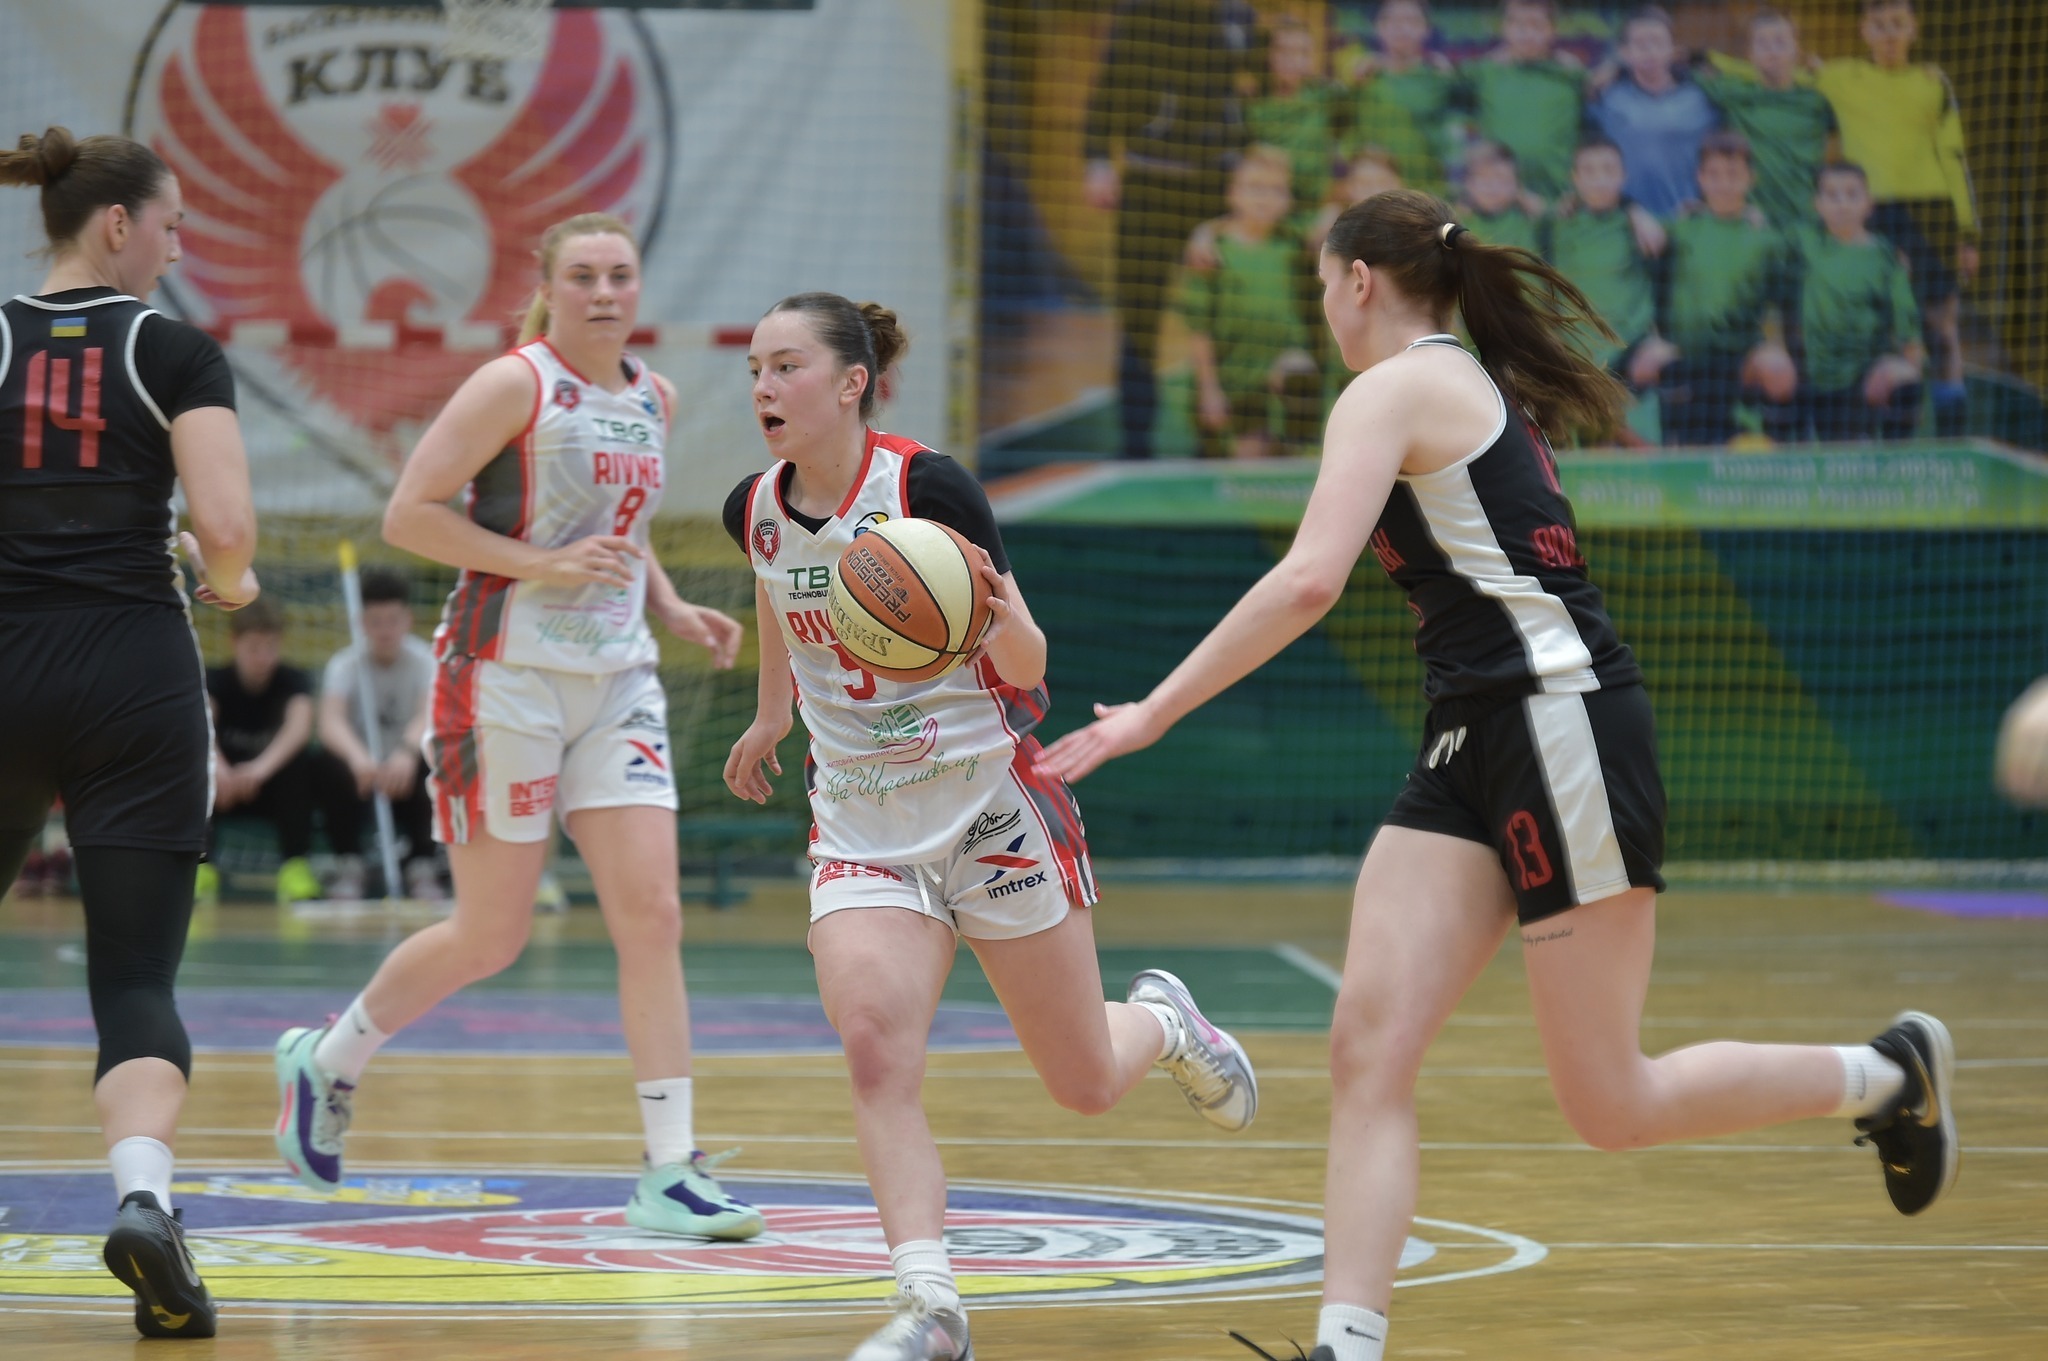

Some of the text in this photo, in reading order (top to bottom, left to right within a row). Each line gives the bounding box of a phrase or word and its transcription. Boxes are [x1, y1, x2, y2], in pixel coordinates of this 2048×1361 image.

[22, 346, 107, 469] 14
[592, 418, 649, 443] TBG
[593, 452, 661, 488] RIVNE
[787, 566, 830, 591] TB
[859, 547, 895, 586] 1000
[788, 590, 829, 601] TECHNOBU
[846, 551, 912, 623] PRECISION
[786, 609, 838, 644] RIV
[1506, 810, 1553, 890] 13
[987, 870, 1048, 900] imtrex
